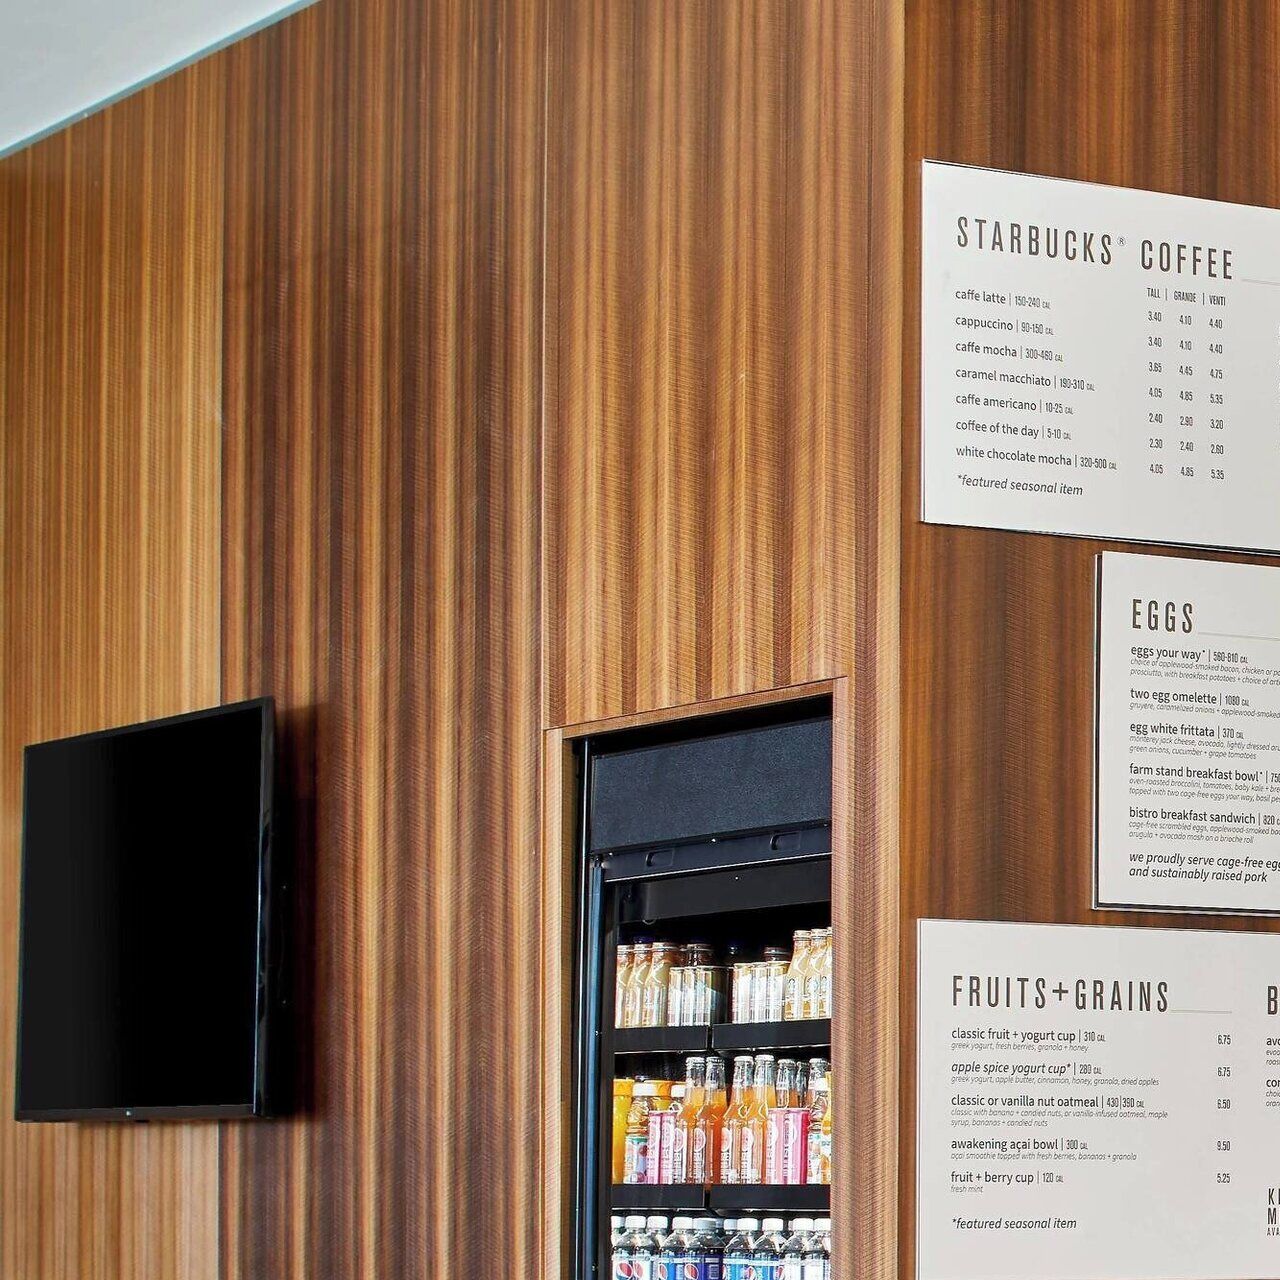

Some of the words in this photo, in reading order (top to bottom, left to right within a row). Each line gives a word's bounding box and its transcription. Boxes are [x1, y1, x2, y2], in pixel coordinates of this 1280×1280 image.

[1141, 239, 1232, 280] COFFEE
[955, 289, 980, 301] caffe
[983, 291, 1006, 304] latte
[1146, 287, 1161, 298] TALL
[1209, 295, 1225, 306] VENTI
[955, 317, 1013, 331] cappuccino
[955, 341, 980, 353] caffe
[983, 345, 1017, 357] mocha
[955, 369, 997, 381] caramel
[999, 373, 1051, 386] macchiato
[956, 393, 980, 405] caffe
[983, 397, 1037, 411] americano
[956, 420, 987, 432] coffee
[989, 422, 1000, 433] of
[1002, 423, 1018, 435] the
[1021, 425, 1039, 439] day
[956, 445, 984, 458] white
[986, 448, 1036, 463] chocolate
[1038, 454, 1072, 466] mocha
[1010, 481, 1057, 493] seasonal
[1059, 483, 1083, 495] item
[1132, 598, 1192, 633] EGGS
[1131, 646, 1154, 658] eggs
[1156, 648, 1179, 659] your
[1130, 688, 1149, 699] two
[1152, 691, 1170, 703] egg
[1172, 692, 1217, 704] omelette
[1130, 723, 1148, 735] egg
[1150, 722, 1178, 735] white
[1180, 724, 1214, 737] frittata
[1129, 762, 1153, 775] farm
[1156, 766, 1183, 777] stand
[1186, 766, 1232, 780] breakfast
[1129, 806, 1158, 818] bistro
[1161, 808, 1207, 821] breakfast
[1209, 812, 1255, 824] sandwich
[1129, 854, 1144, 862] we
[1146, 853, 1186, 867] proudly
[1187, 856, 1215, 867] serve
[1216, 856, 1264, 869] cage-free
[1129, 865, 1149, 877] and
[1151, 867, 1210, 882] sustainably
[1211, 869, 1243, 881] raised
[1244, 871, 1268, 884] pork
[953, 975, 1168, 1012] FRUITS+GRAINS
[951, 1027, 985, 1039] classic
[988, 1027, 1010, 1040] fruit
[1020, 1030, 1055, 1043] yogurt
[1057, 1032, 1076, 1044] cup
[951, 1061, 981, 1074] apple
[983, 1061, 1009, 1075] spice
[1011, 1063, 1047, 1076] yogurt
[951, 1094, 985, 1106] classic
[987, 1097, 999, 1106] or
[1001, 1095, 1034, 1106] vanilla
[1037, 1096, 1055, 1107] nut
[1057, 1096, 1099, 1107] oatmeal
[951, 1138, 1007, 1152] awakening
[1033, 1138, 1058, 1149] bowl
[951, 1171, 973, 1182] fruit
[984, 1171, 1013, 1185] berry
[1015, 1174, 1034, 1185] cup
[1004, 1217, 1051, 1229] seasonal
[1053, 1217, 1076, 1228] item
